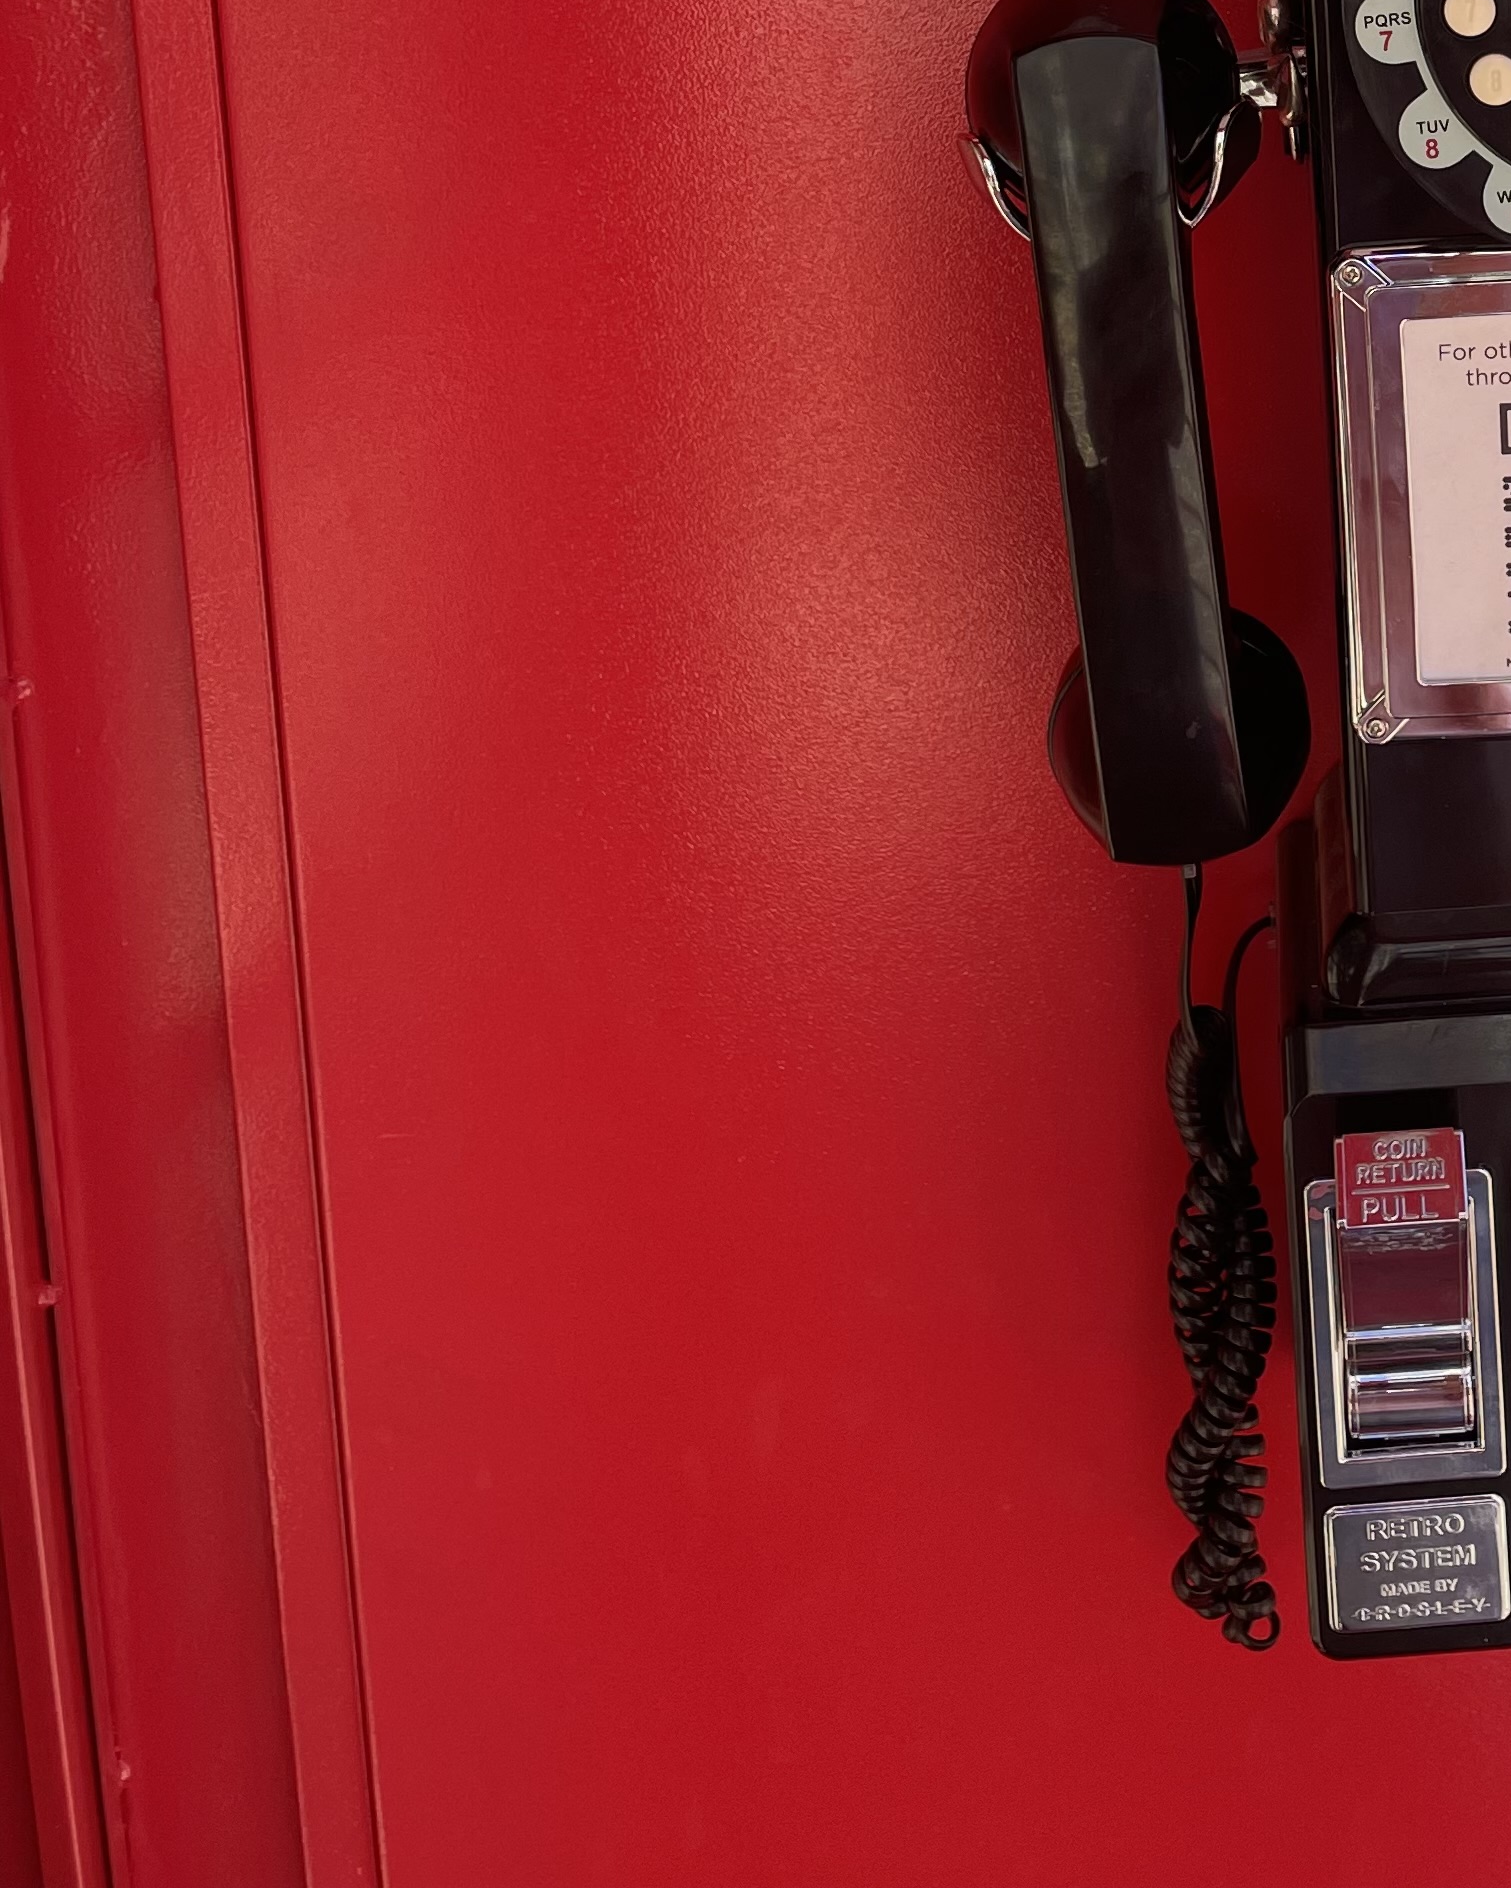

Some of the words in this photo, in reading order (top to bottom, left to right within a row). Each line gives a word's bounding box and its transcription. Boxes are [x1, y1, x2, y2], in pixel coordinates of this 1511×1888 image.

[1363, 11, 1412, 28] PQRS
[1379, 31, 1393, 51] 7
[1416, 119, 1450, 135] TUV
[1424, 139, 1440, 159] 8
[1439, 344, 1477, 361] For
[1373, 1136, 1427, 1161] COIN
[1356, 1157, 1445, 1185] RETURN
[1362, 1194, 1439, 1223] PULL
[1366, 1513, 1465, 1541] RETRO
[1360, 1543, 1477, 1572] SYSTEM
[1380, 1580, 1432, 1597] MADE
[1435, 1578, 1459, 1592] BY
[1354, 1597, 1487, 1621] CROSLEY
